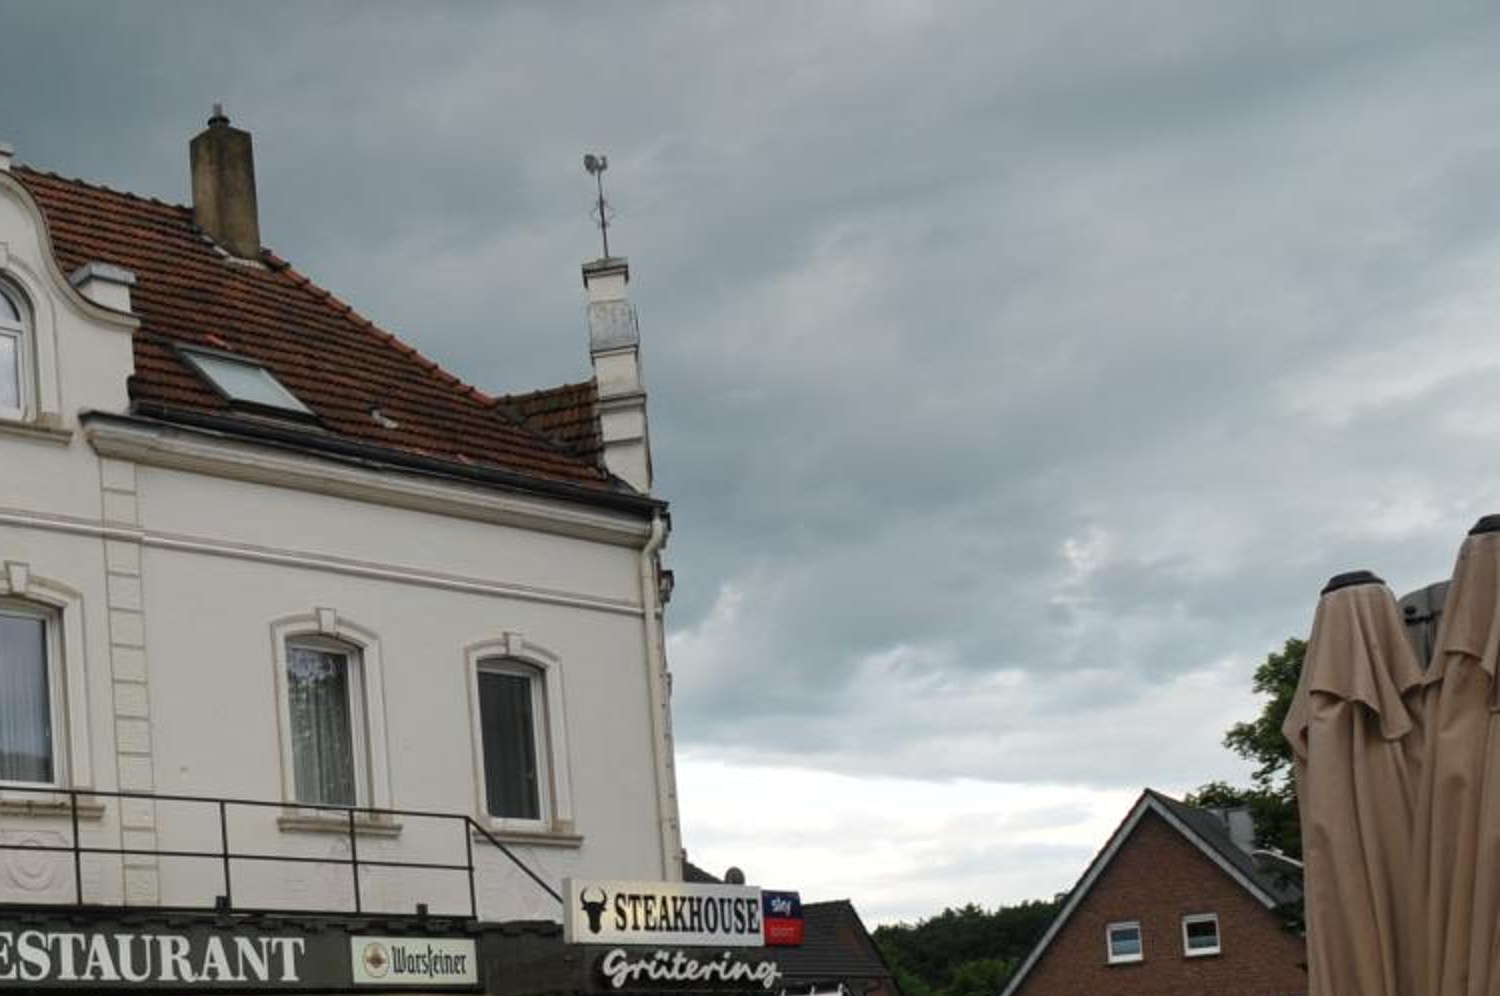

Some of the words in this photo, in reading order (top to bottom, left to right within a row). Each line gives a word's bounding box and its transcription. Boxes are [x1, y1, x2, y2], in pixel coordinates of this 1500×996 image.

[613, 892, 761, 935] STEAKHOUSE
[770, 896, 792, 917] sky
[391, 943, 467, 979] Warsteiner
[602, 948, 782, 988] Grütering
